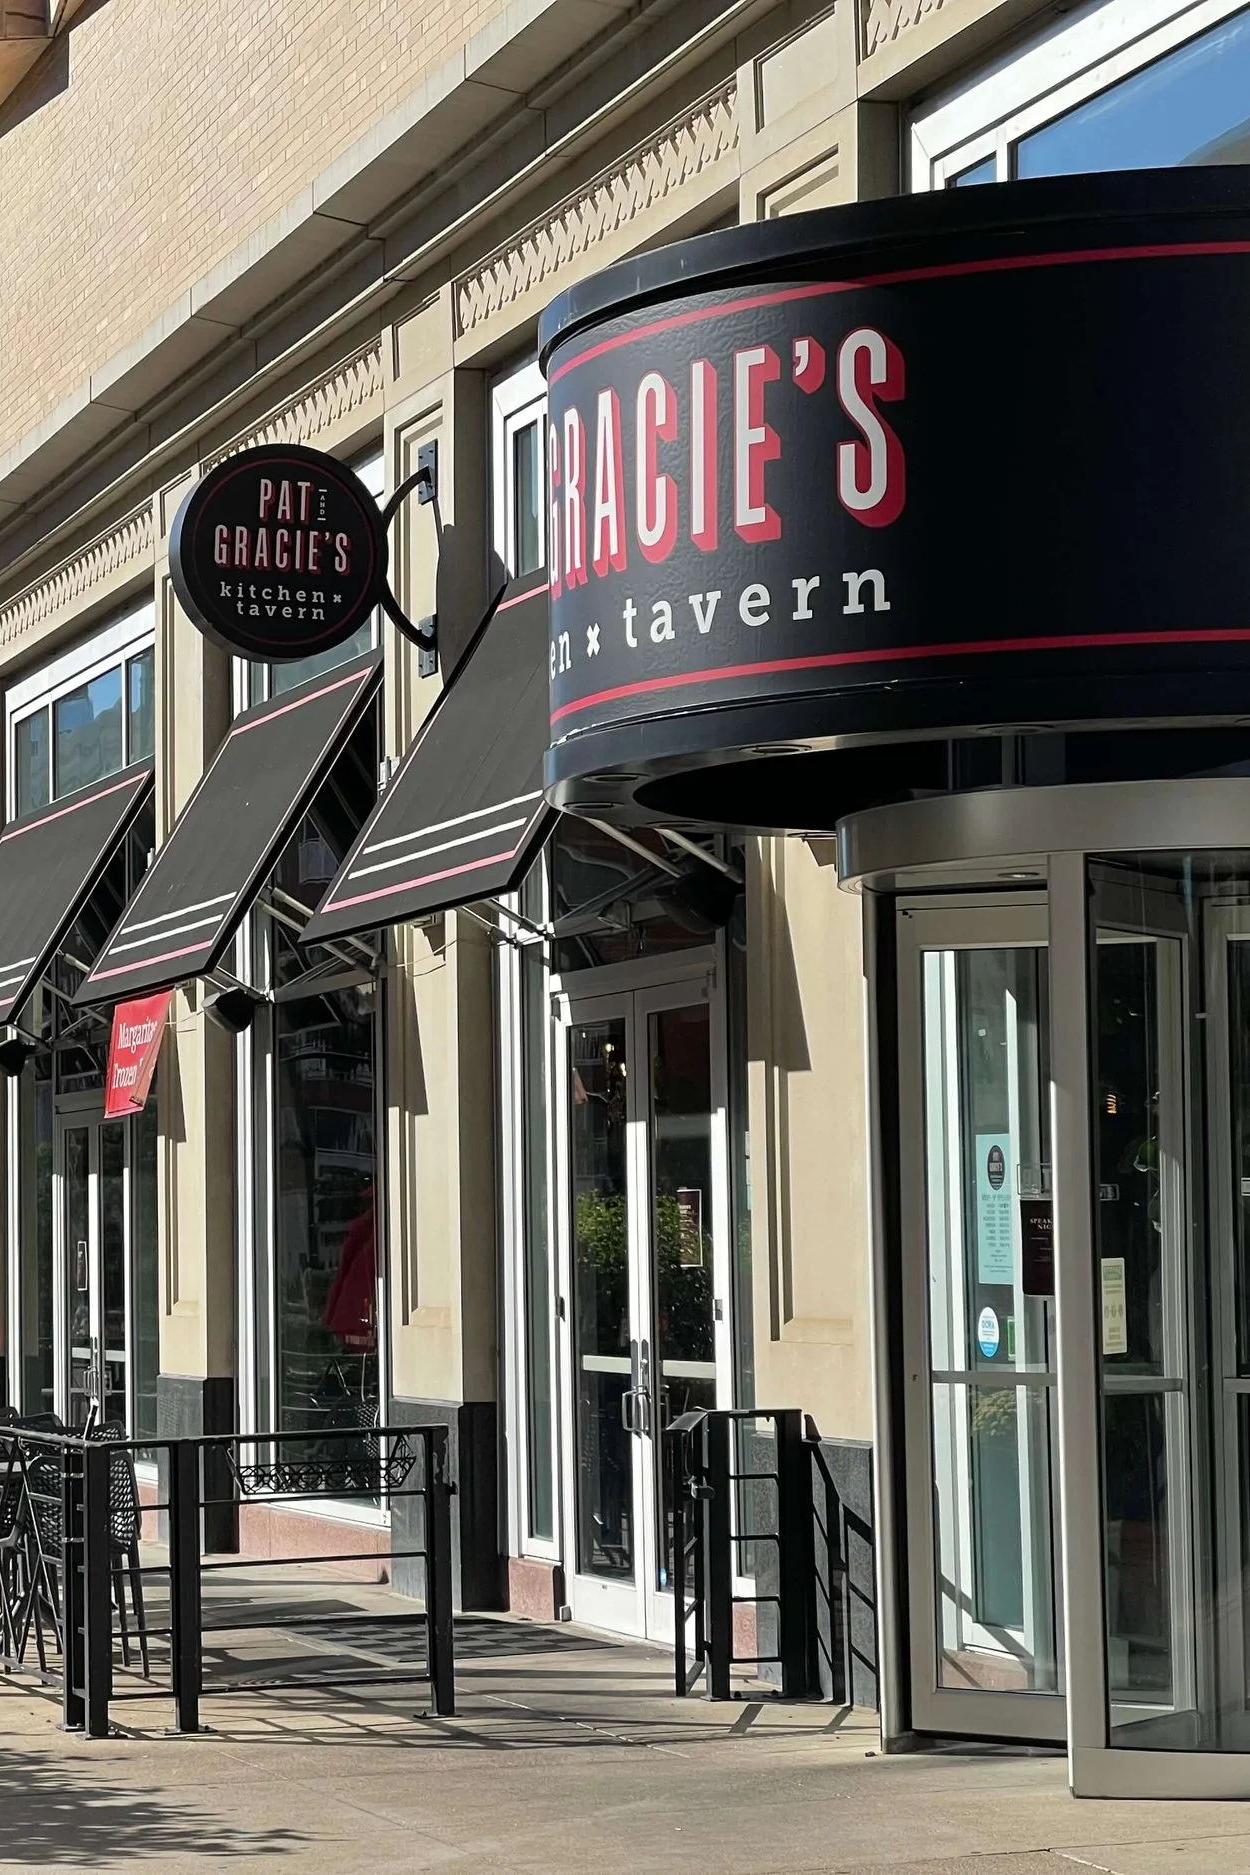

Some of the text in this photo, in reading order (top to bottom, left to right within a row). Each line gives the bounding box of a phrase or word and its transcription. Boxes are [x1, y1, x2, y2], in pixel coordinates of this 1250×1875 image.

[549, 327, 906, 600] GRACIE'S
[259, 478, 314, 523] PAT
[214, 524, 350, 575] GRACIE'S
[219, 582, 325, 603] kitchen
[236, 601, 325, 620] tavern
[623, 567, 890, 648] tavern
[111, 1063, 138, 1089] Frozen
